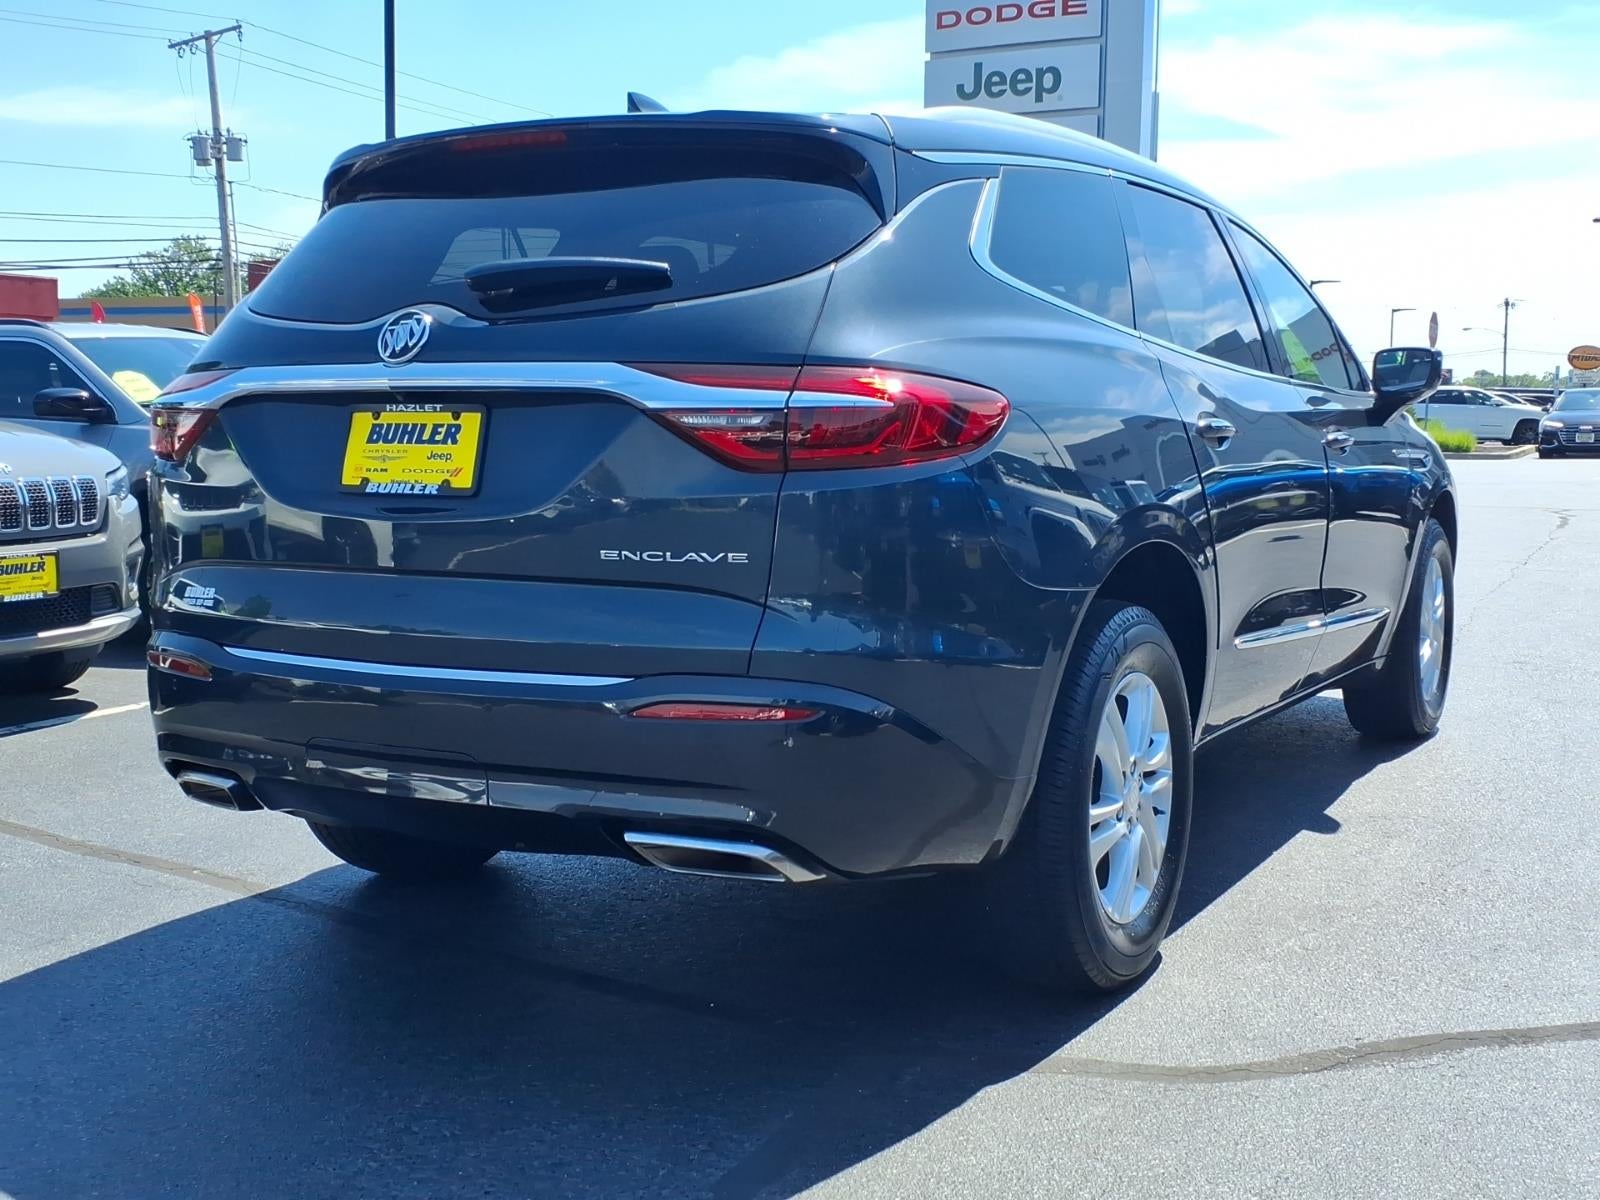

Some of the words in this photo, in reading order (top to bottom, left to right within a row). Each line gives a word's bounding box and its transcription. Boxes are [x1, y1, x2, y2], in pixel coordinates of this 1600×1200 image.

[936, 0, 1088, 30] DODGE
[956, 61, 1062, 104] Jeep
[386, 404, 443, 412] HAZLET
[366, 422, 462, 445] BUHLER
[426, 450, 453, 462] Jeep
[365, 483, 439, 495] BUHLER
[600, 550, 749, 563] ENCLAVE
